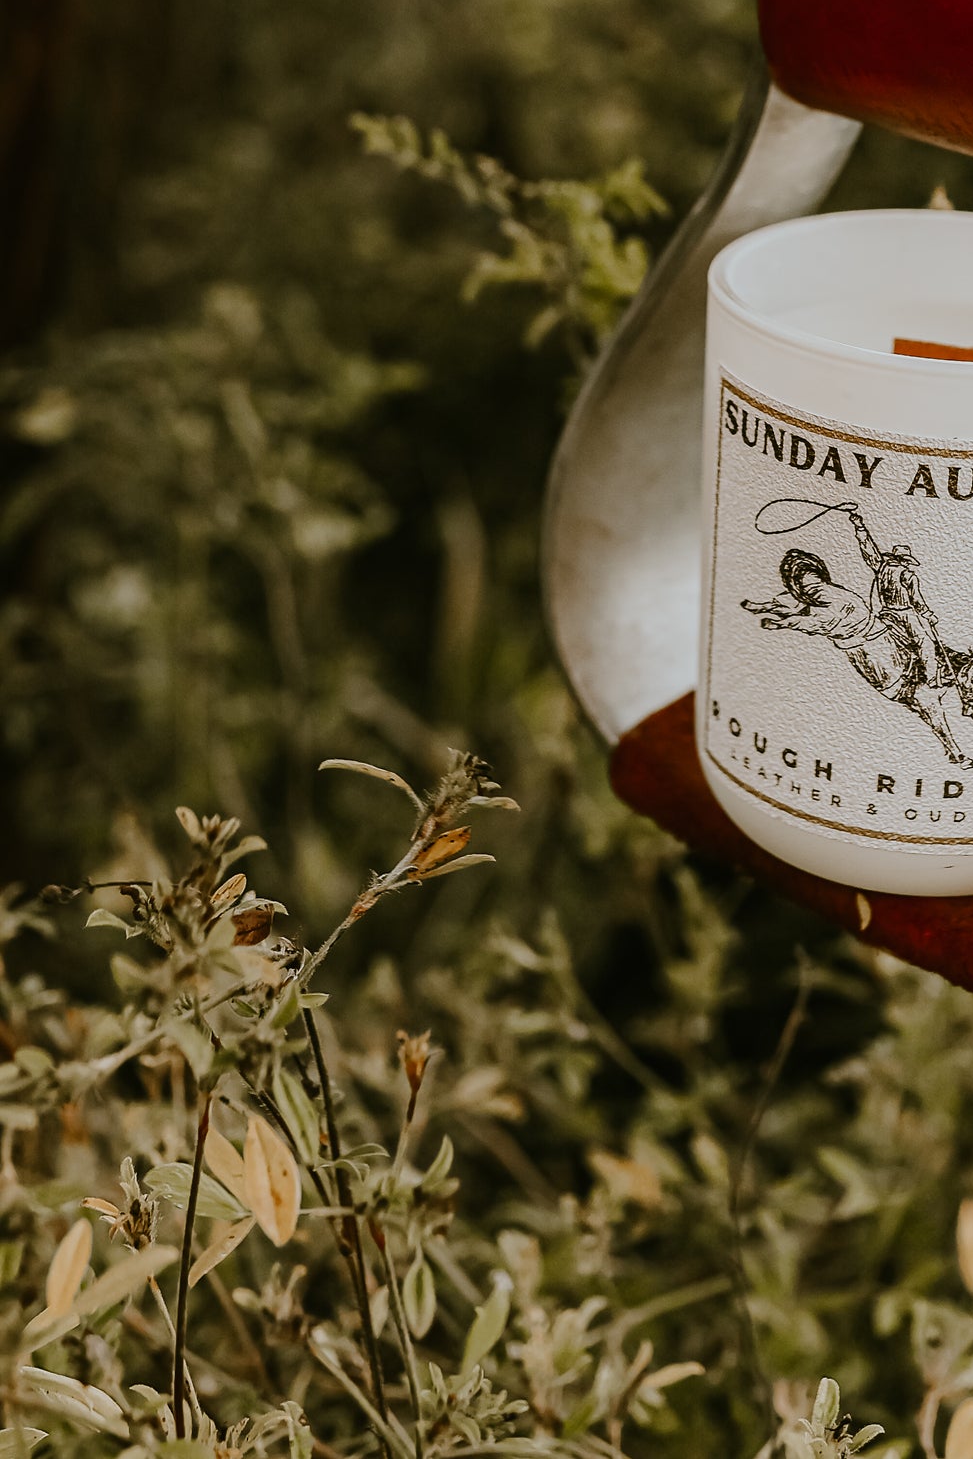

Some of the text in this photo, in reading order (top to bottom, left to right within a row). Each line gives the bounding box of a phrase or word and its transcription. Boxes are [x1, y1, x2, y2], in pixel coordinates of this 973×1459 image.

[724, 398, 885, 489] SUNDAY
[731, 747, 843, 807] LEATHER
[865, 802, 879, 816] &
